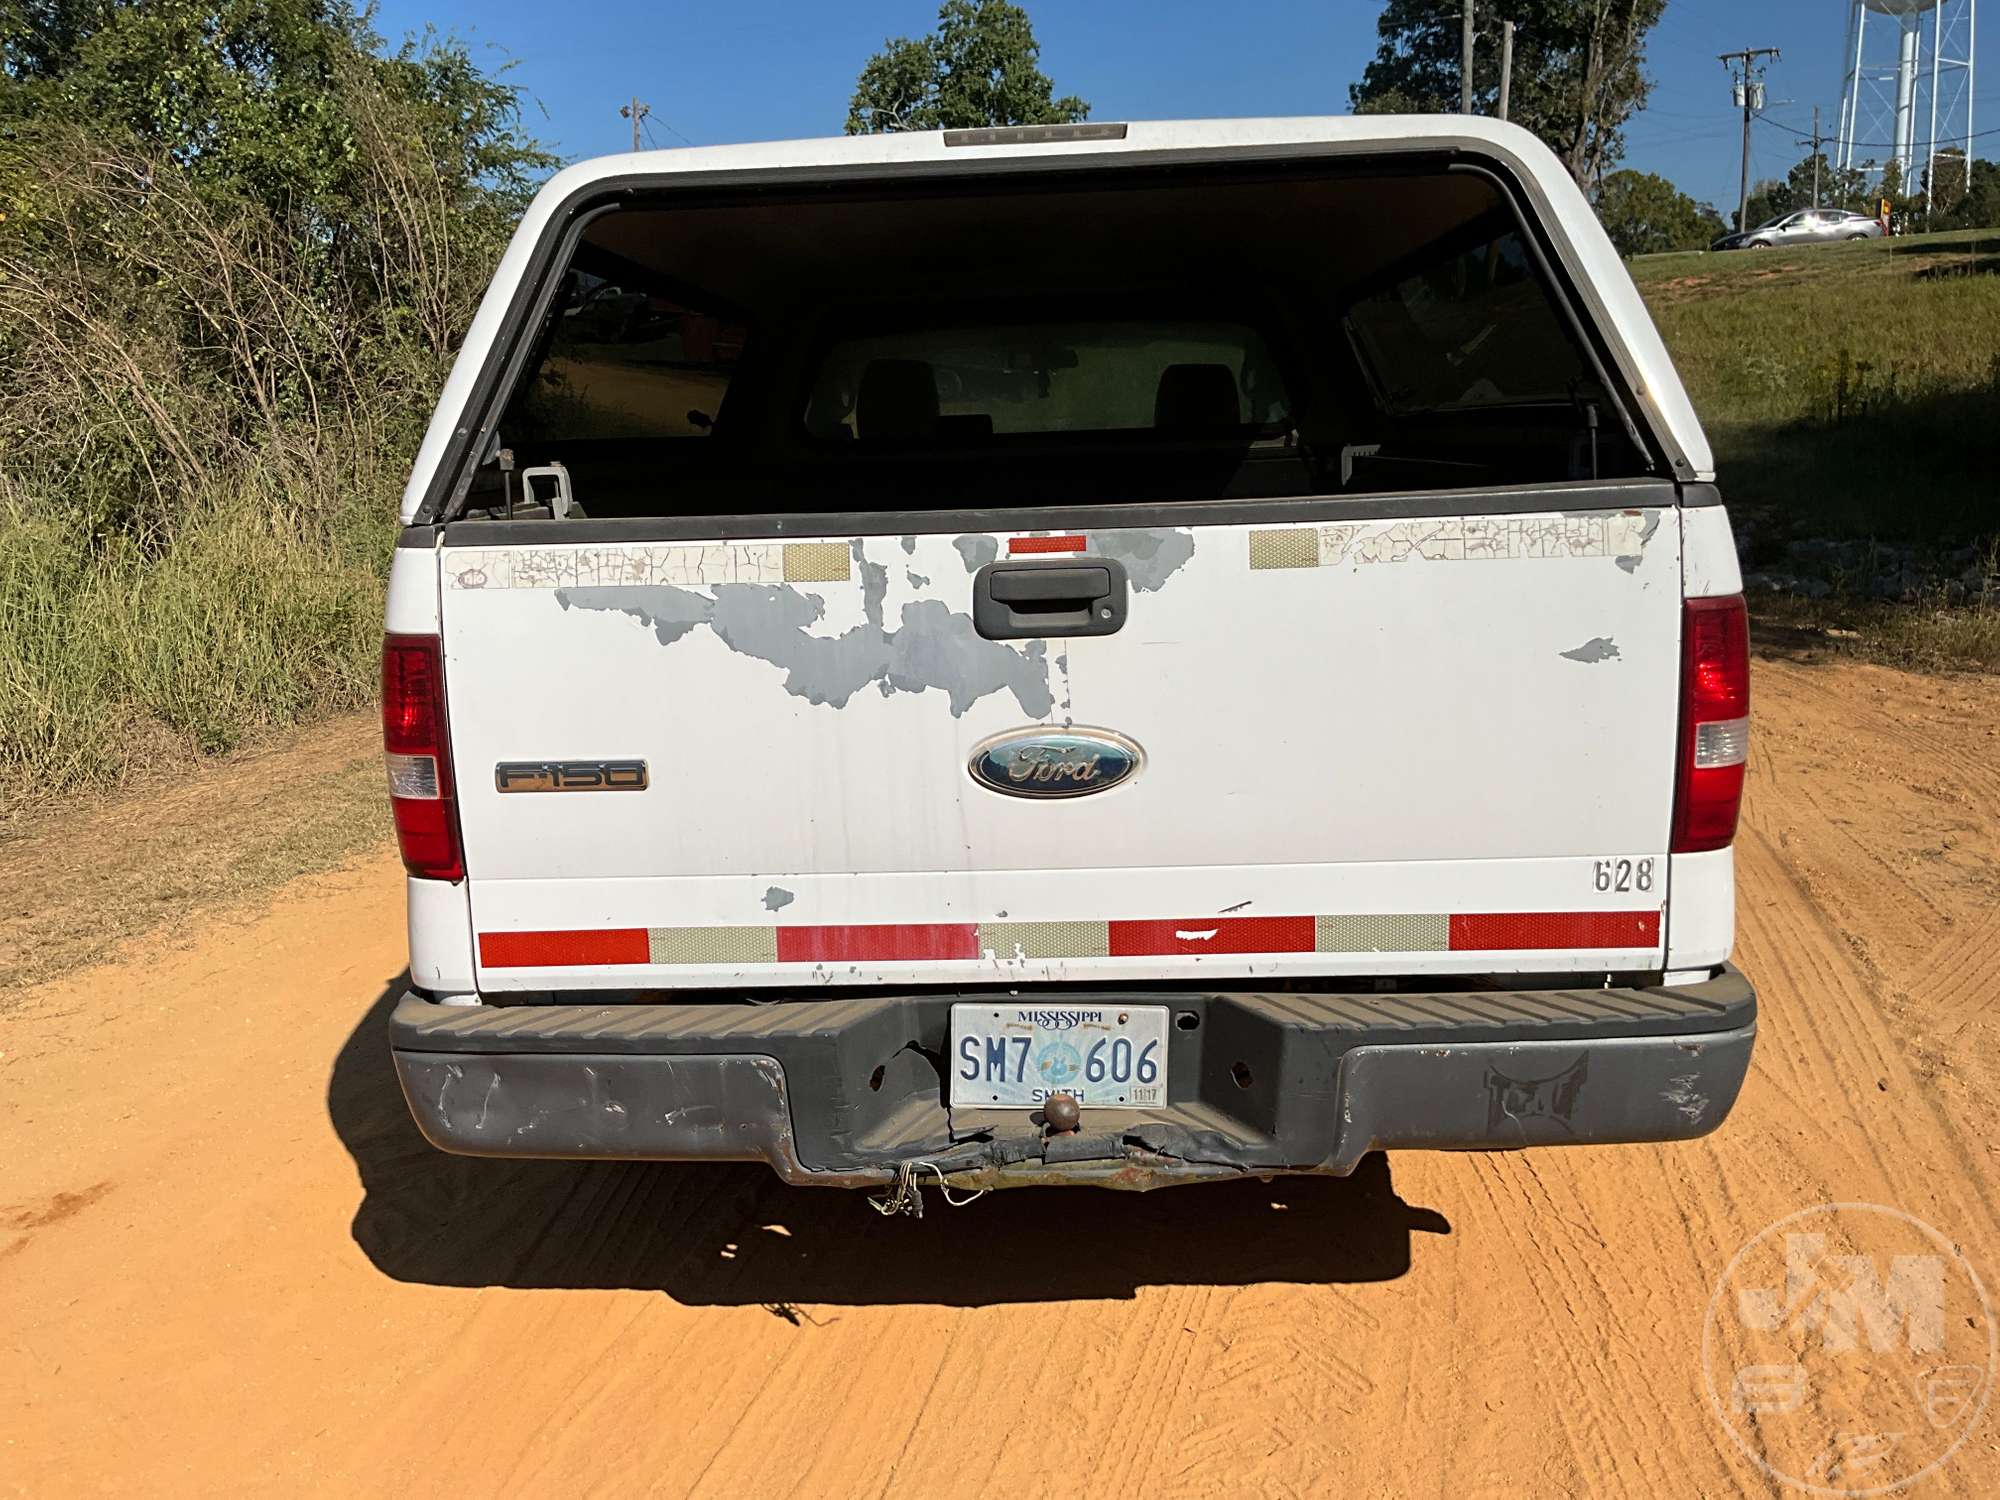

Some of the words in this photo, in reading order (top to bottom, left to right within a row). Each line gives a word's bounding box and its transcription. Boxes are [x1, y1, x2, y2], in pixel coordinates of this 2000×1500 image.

[1008, 744, 1101, 782] Ford
[1594, 858, 1652, 892] 628
[1018, 1011, 1102, 1031] MISSISSIPPI
[960, 1036, 1032, 1083] SM7
[1085, 1038, 1158, 1084] 606
